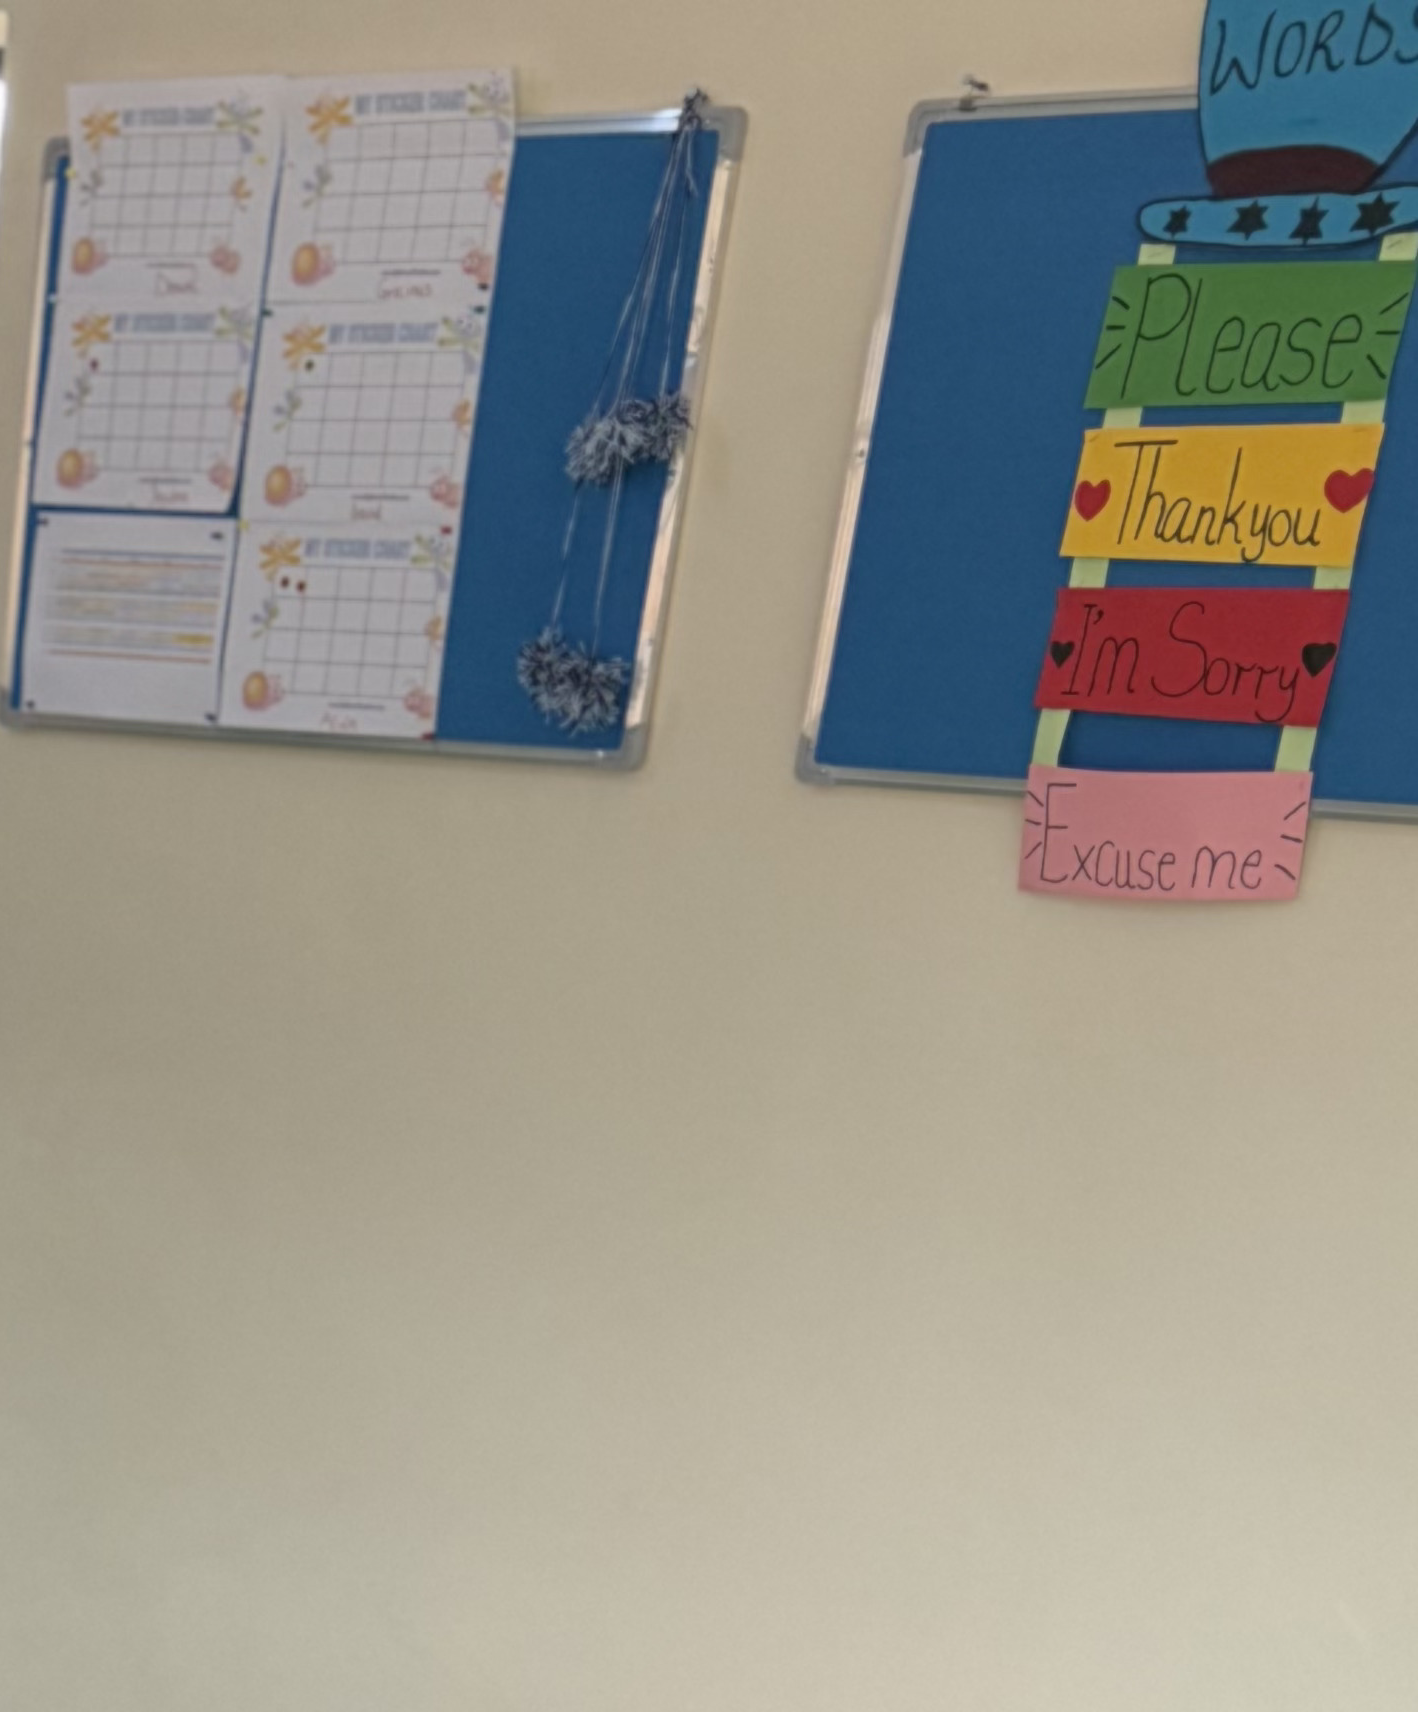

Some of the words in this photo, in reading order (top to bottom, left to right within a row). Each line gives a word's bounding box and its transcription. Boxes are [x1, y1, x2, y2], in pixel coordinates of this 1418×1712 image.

[1121, 273, 1362, 399] Please
[1061, 603, 1139, 697] I'm
[1151, 601, 1300, 723] Sorry
[1040, 783, 1176, 891] Excuse
[1191, 846, 1262, 890] me
